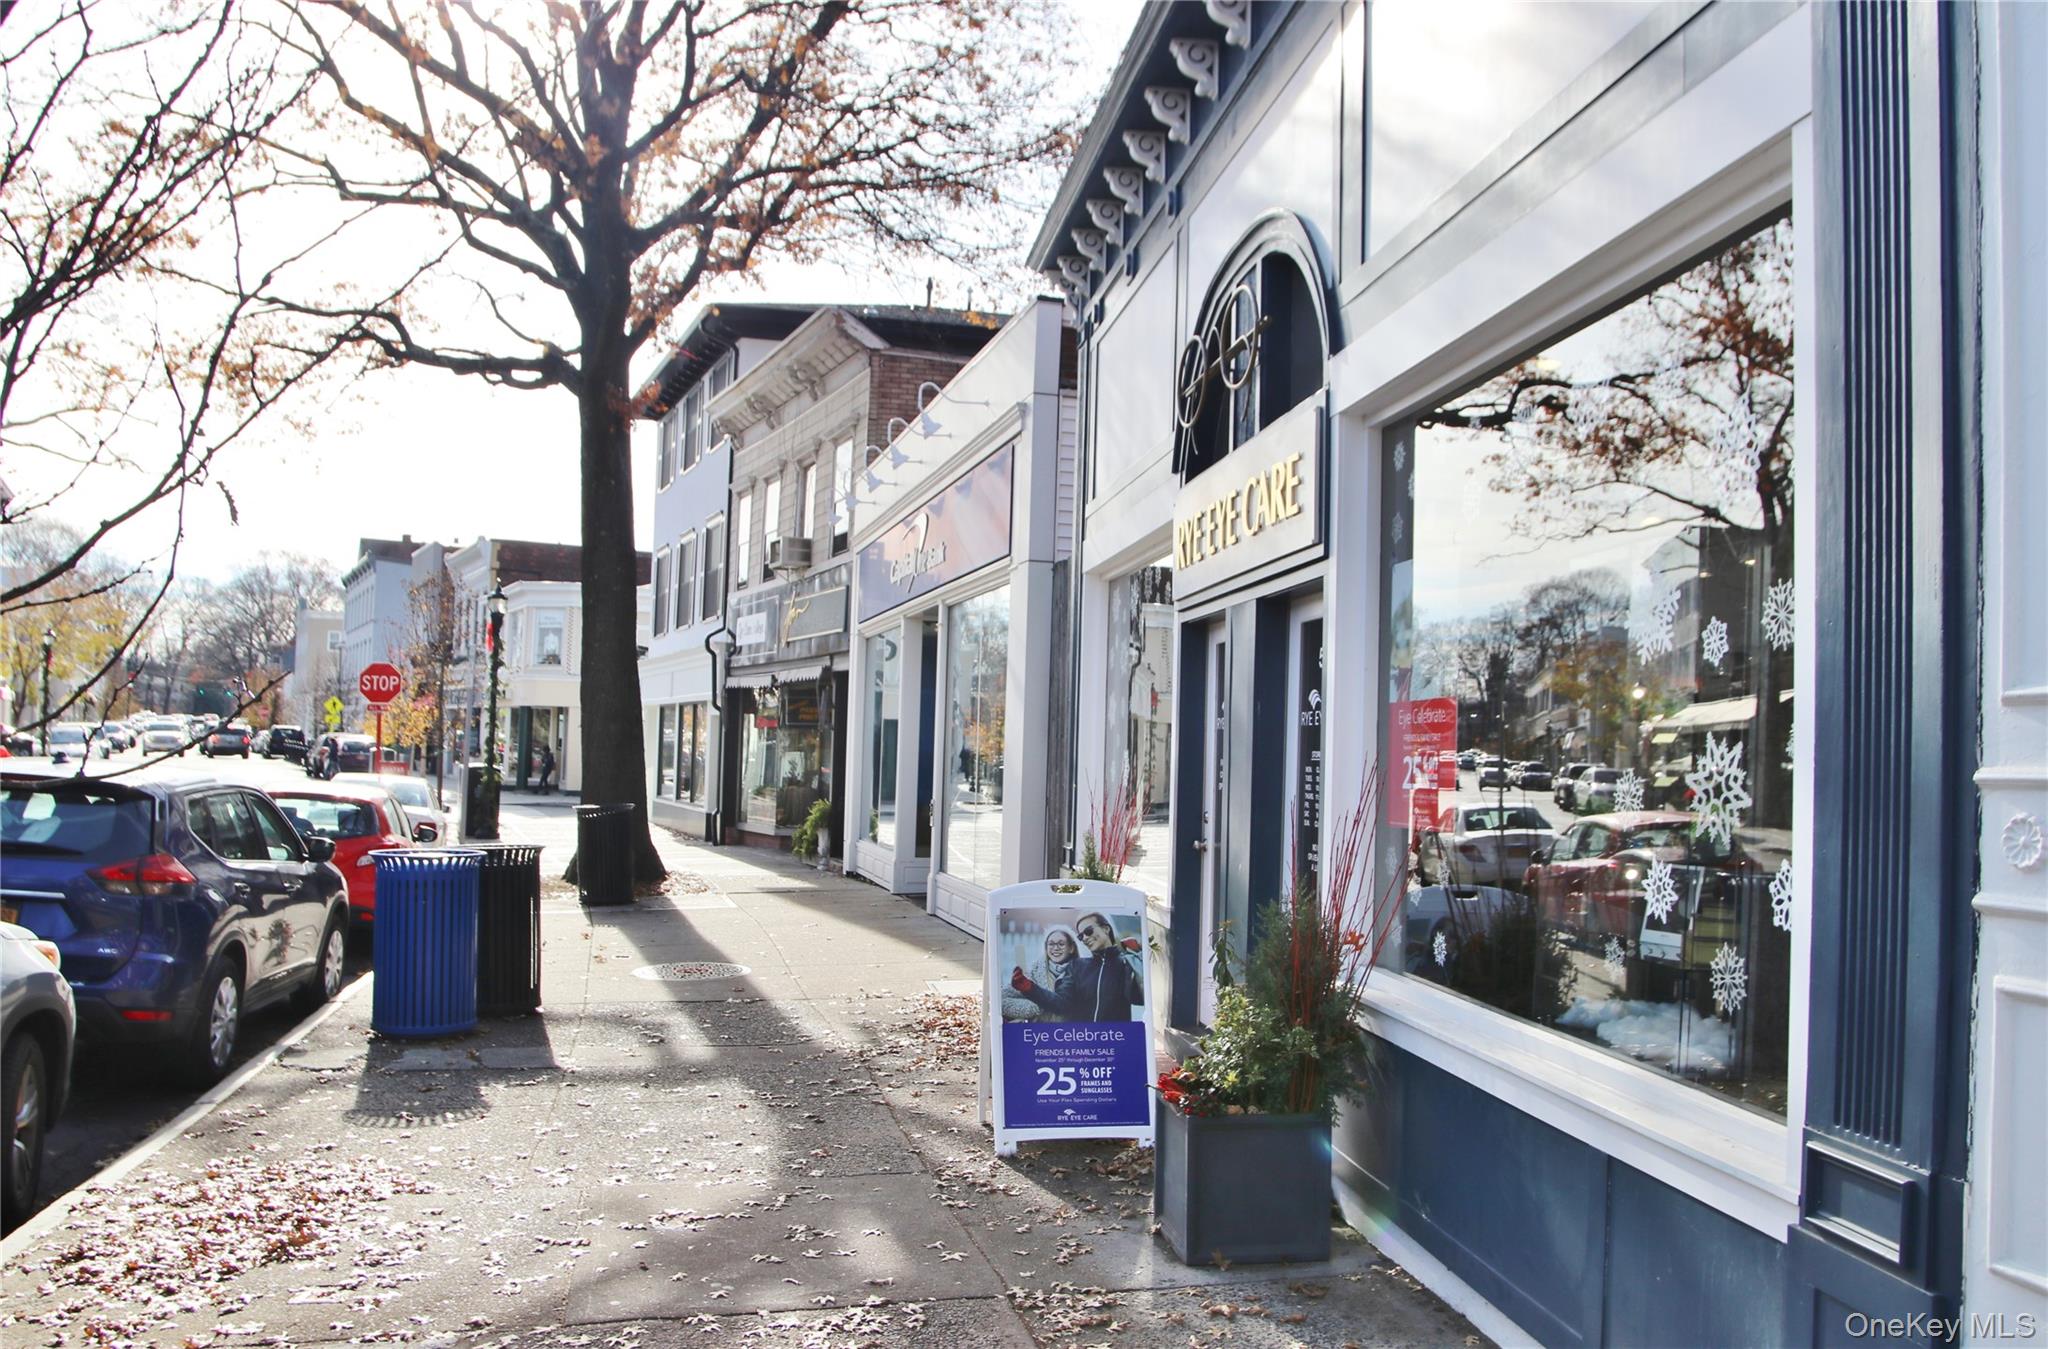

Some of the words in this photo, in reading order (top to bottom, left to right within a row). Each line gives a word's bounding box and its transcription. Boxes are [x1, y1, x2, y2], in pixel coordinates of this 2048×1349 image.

[1176, 511, 1203, 571] RYE
[1206, 489, 1238, 558] EYE
[1241, 451, 1302, 537] CARE
[361, 674, 399, 691] STOP
[1314, 711, 1322, 726] EY
[1023, 1029, 1049, 1046] Eye
[1035, 1048, 1064, 1056] FRIENDS
[1065, 1048, 1070, 1056] &
[1071, 1048, 1096, 1056] FAMILY
[1036, 1066, 1077, 1095] 25
[1079, 1067, 1090, 1079] %
